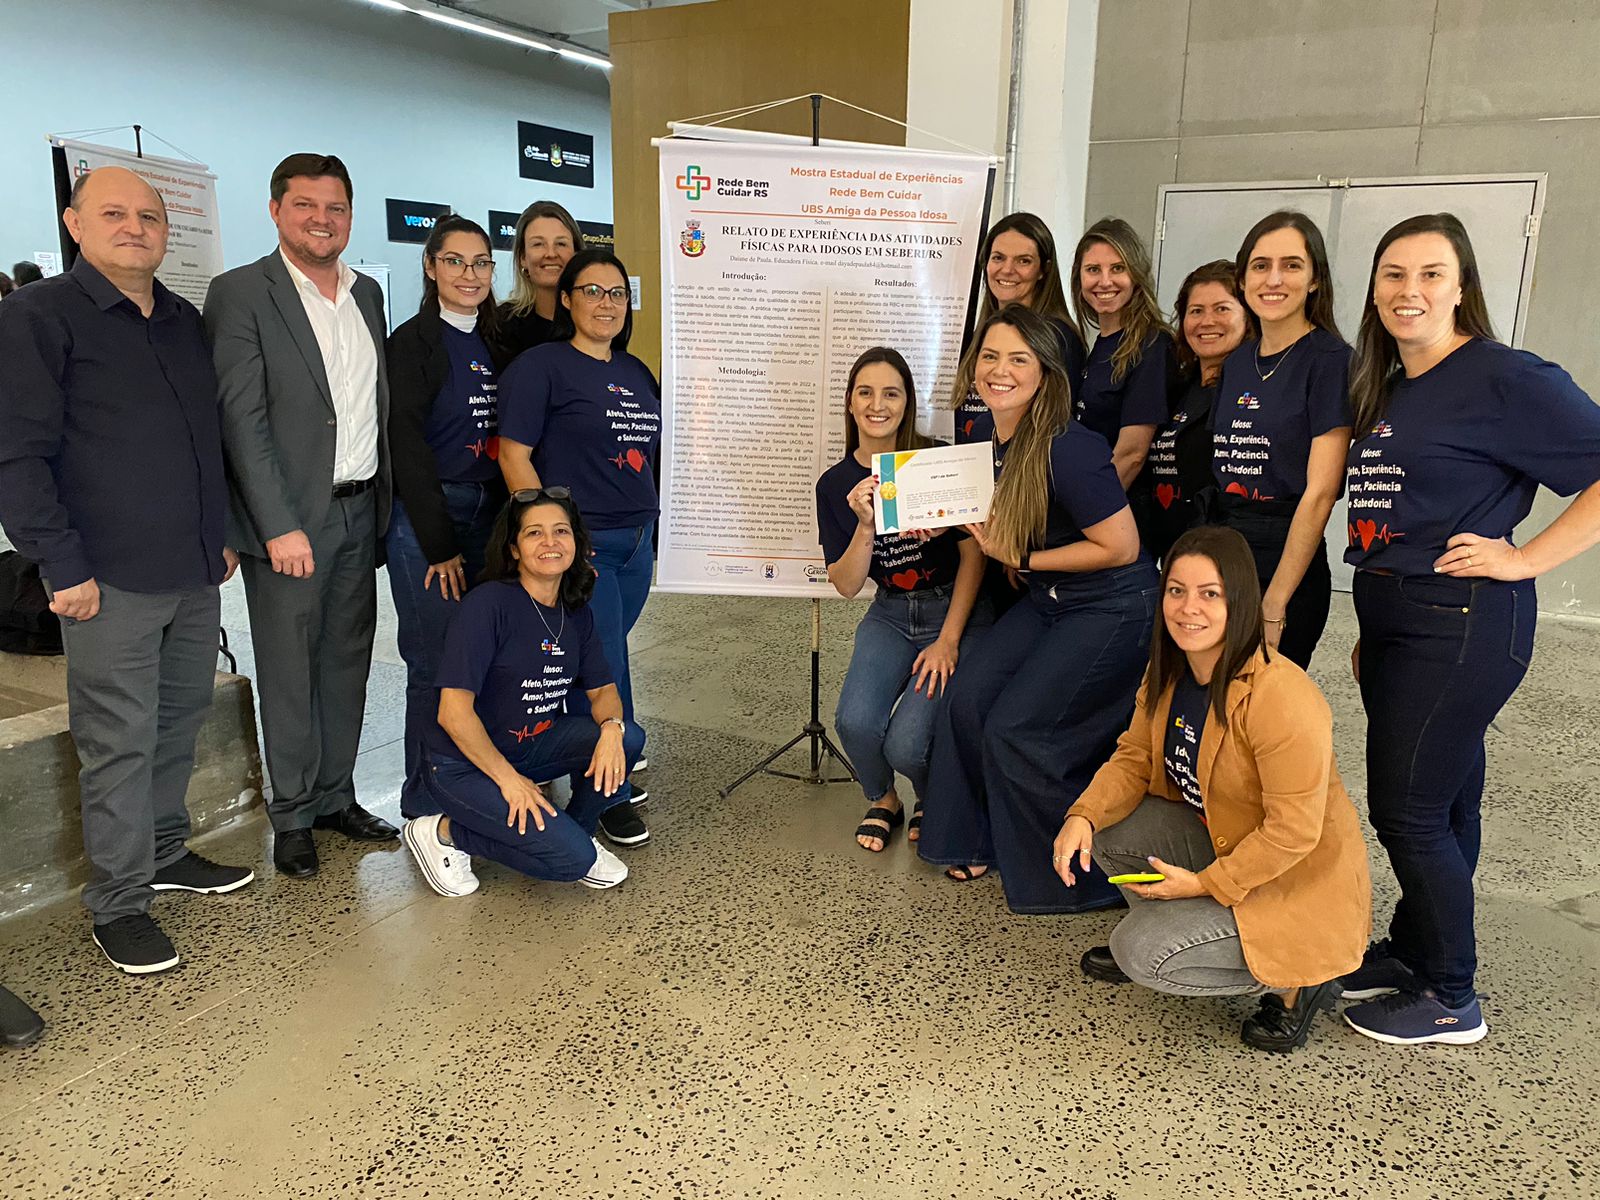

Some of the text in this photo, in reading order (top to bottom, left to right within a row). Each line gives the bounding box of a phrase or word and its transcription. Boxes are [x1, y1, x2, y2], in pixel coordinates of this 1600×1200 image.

[790, 168, 964, 184] Mostra Estadual de Experiências
[717, 178, 770, 188] Rede Bem
[717, 188, 768, 198] Cuidar RS
[830, 188, 922, 200] Rede Bem Cuidar
[801, 204, 948, 220] UBS Amiga da Pessoa Idosa
[722, 226, 963, 246] RELATO DE EXPERIÊNCIA DAS ATIVIDADES
[740, 239, 943, 259] FÍSICAS PARA IDOSOS EM SEBERI/RS
[722, 271, 767, 281] Introdução:
[874, 278, 918, 288] Resultados:
[718, 366, 766, 377] Metodologia:
[611, 422, 630, 430] Amor,
[1232, 420, 1252, 429] Idoso:
[1230, 434, 1271, 447] Experiência,
[1361, 449, 1382, 458] Idoso:
[1361, 464, 1405, 477] Experiência,
[1364, 481, 1401, 492] Paciência
[521, 679, 542, 689] Afeto,
[522, 693, 544, 702] Amor,
